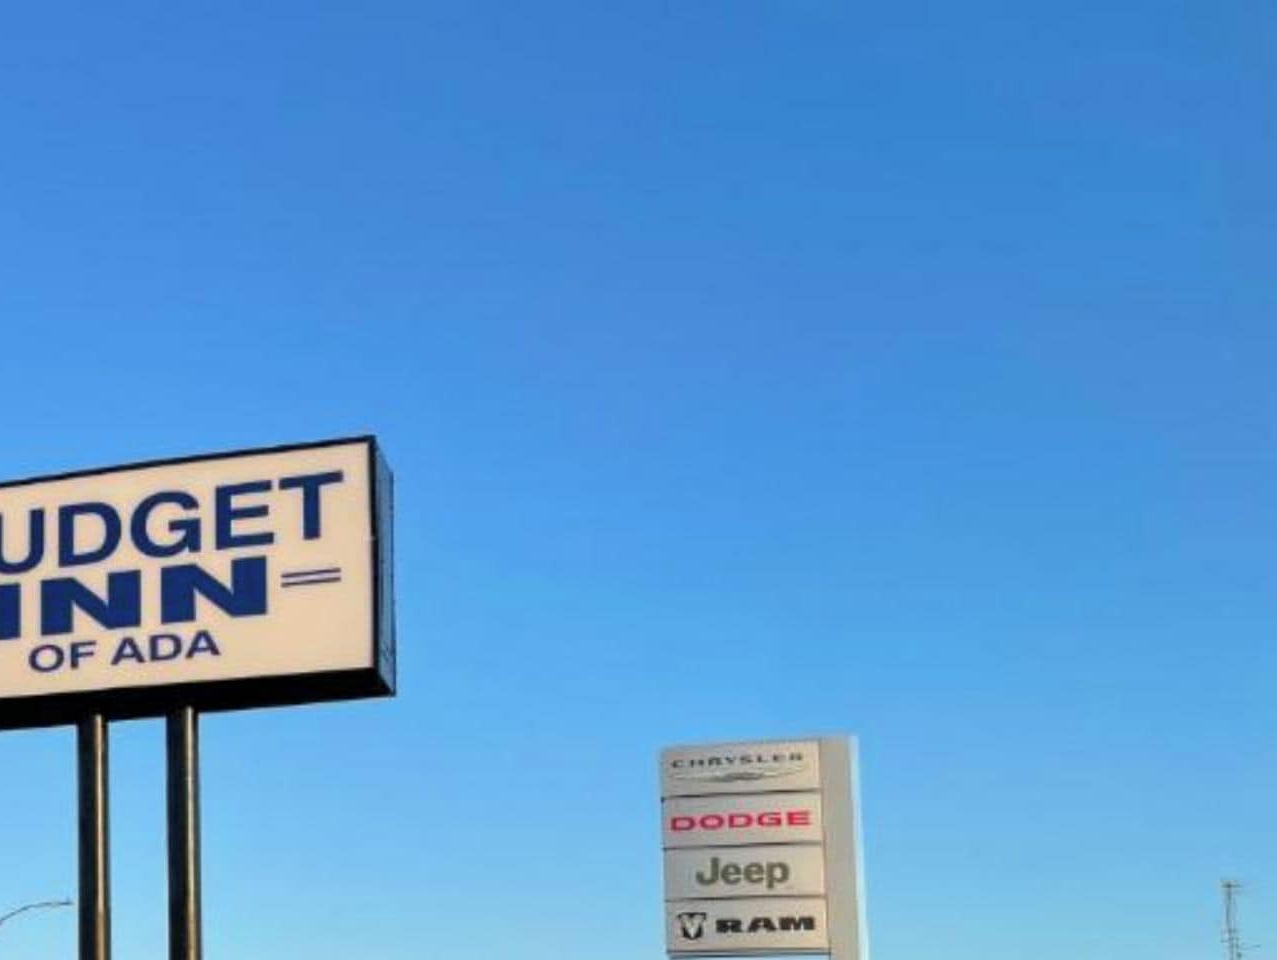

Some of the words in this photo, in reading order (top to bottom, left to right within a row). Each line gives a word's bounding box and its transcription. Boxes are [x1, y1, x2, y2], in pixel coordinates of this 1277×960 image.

[28, 640, 97, 673] OF
[110, 629, 221, 667] ADA
[671, 752, 804, 768] CHRYSLER
[670, 810, 812, 832] DODGE
[695, 856, 790, 889] Jeep
[715, 916, 816, 934] RAM
